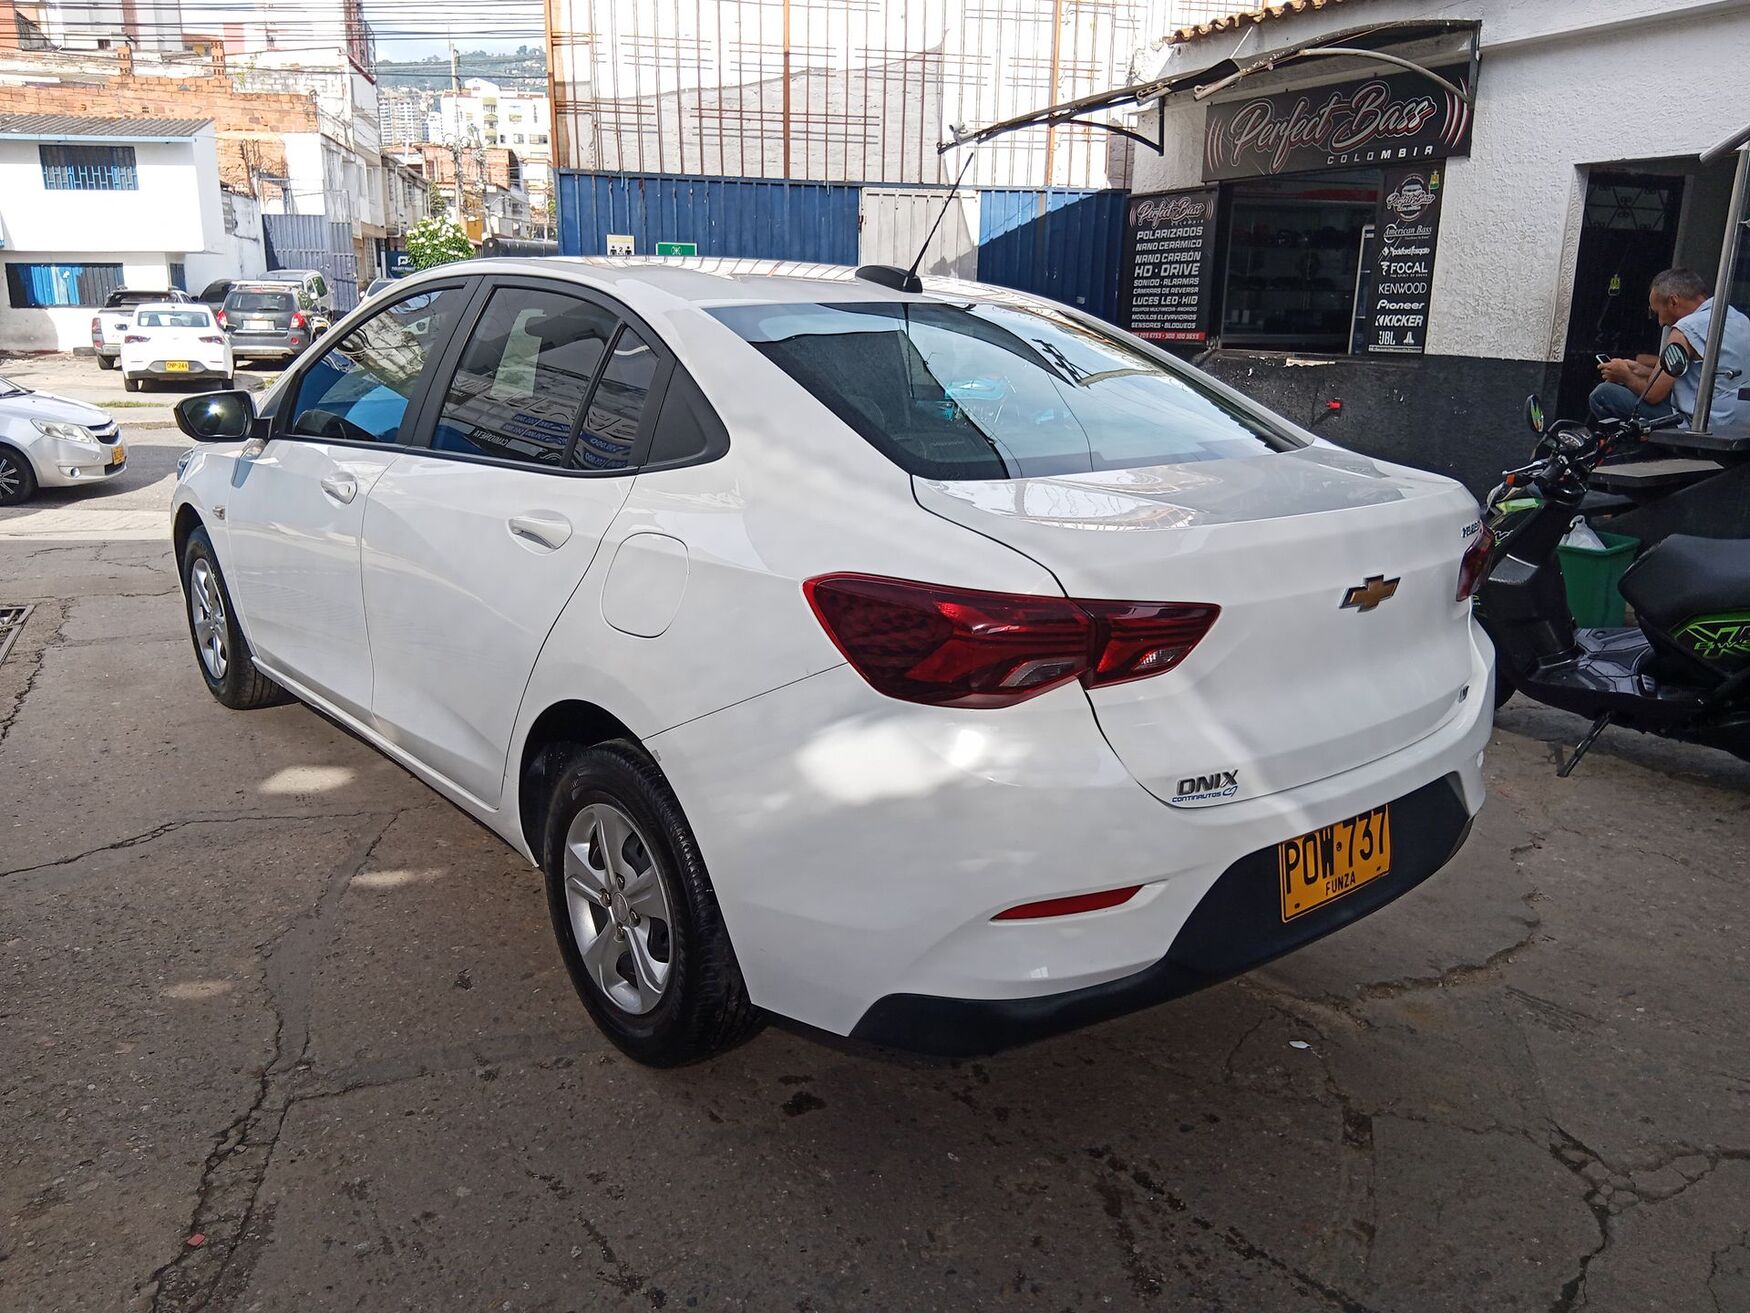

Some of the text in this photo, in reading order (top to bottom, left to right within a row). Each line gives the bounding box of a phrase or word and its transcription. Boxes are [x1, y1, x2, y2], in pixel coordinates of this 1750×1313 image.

[1229, 82, 1436, 173] Perfect Bass
[1327, 145, 1433, 165] COLOMBIA
[1172, 197, 1205, 222] Bass
[1136, 226, 1204, 240] POLARIZADOS
[1384, 225, 1432, 237] American Bass
[1136, 239, 1202, 252] NANO CERÁMICO
[1135, 251, 1201, 264] NANO CARBÓN
[1134, 263, 1200, 277] HD DRIVE
[1390, 262, 1428, 274] FOCAL
[1133, 277, 1199, 287] SONIDO ALARMAS
[1378, 282, 1427, 295] KENWOOD
[1132, 296, 1159, 305] LUCES
[1376, 299, 1425, 310] Pioneer
[1177, 769, 1239, 796] ONIX
[1172, 791, 1222, 803] CONTINAUTOS
[1325, 871, 1356, 896] FUNZA
